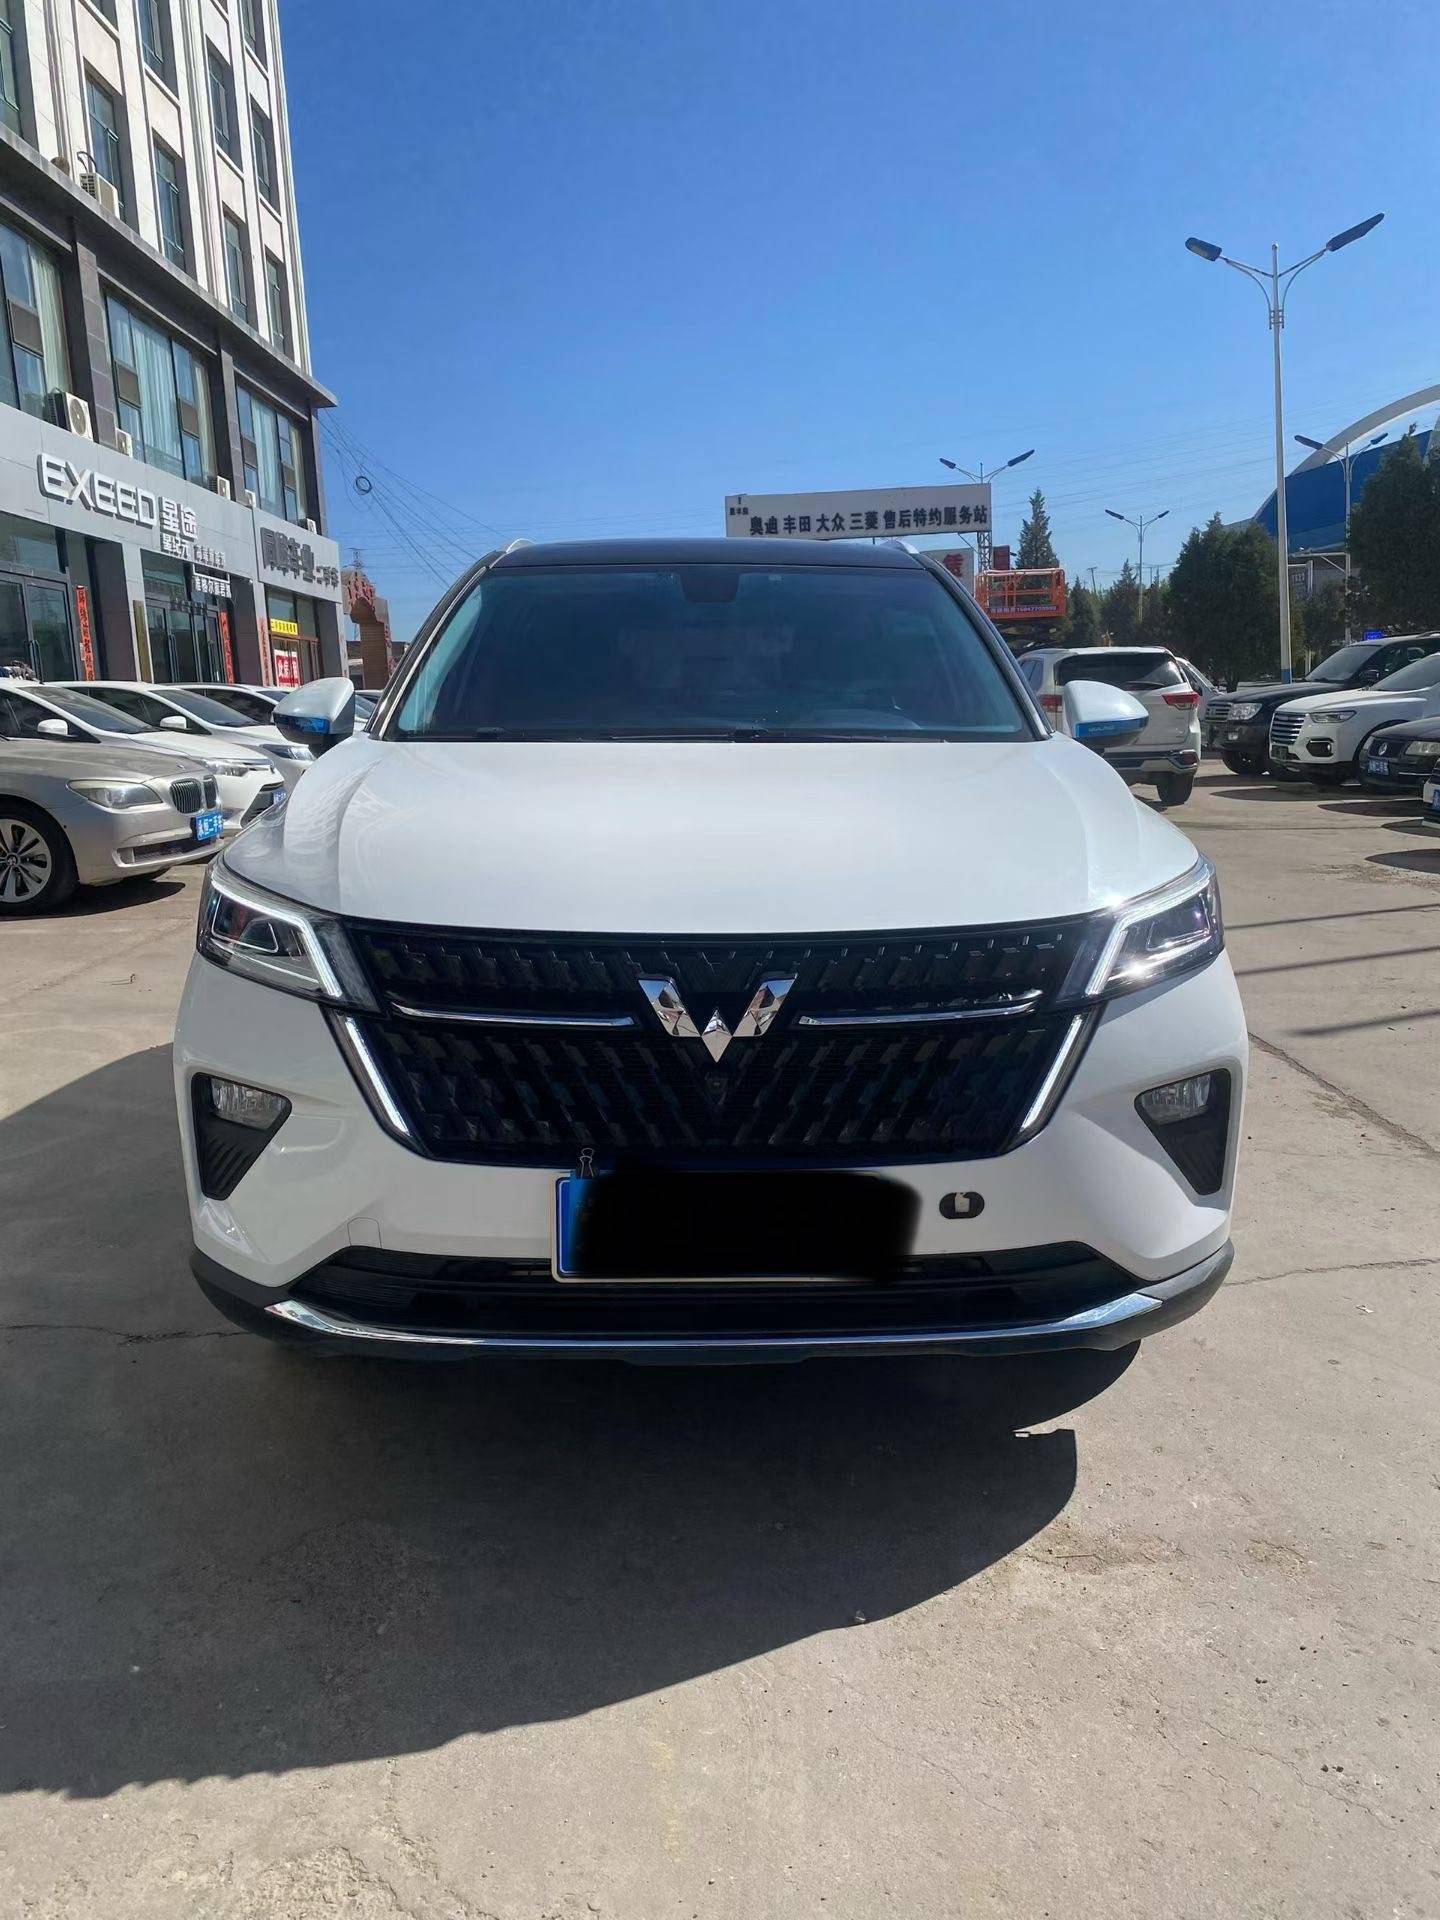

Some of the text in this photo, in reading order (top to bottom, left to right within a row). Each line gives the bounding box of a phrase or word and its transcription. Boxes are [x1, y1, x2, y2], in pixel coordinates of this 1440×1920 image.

[38, 453, 157, 528] EXEED
[160, 496, 198, 540] 星途
[750, 505, 988, 536] 奥迪 丰田 大众 三菱 售后特约服务站
